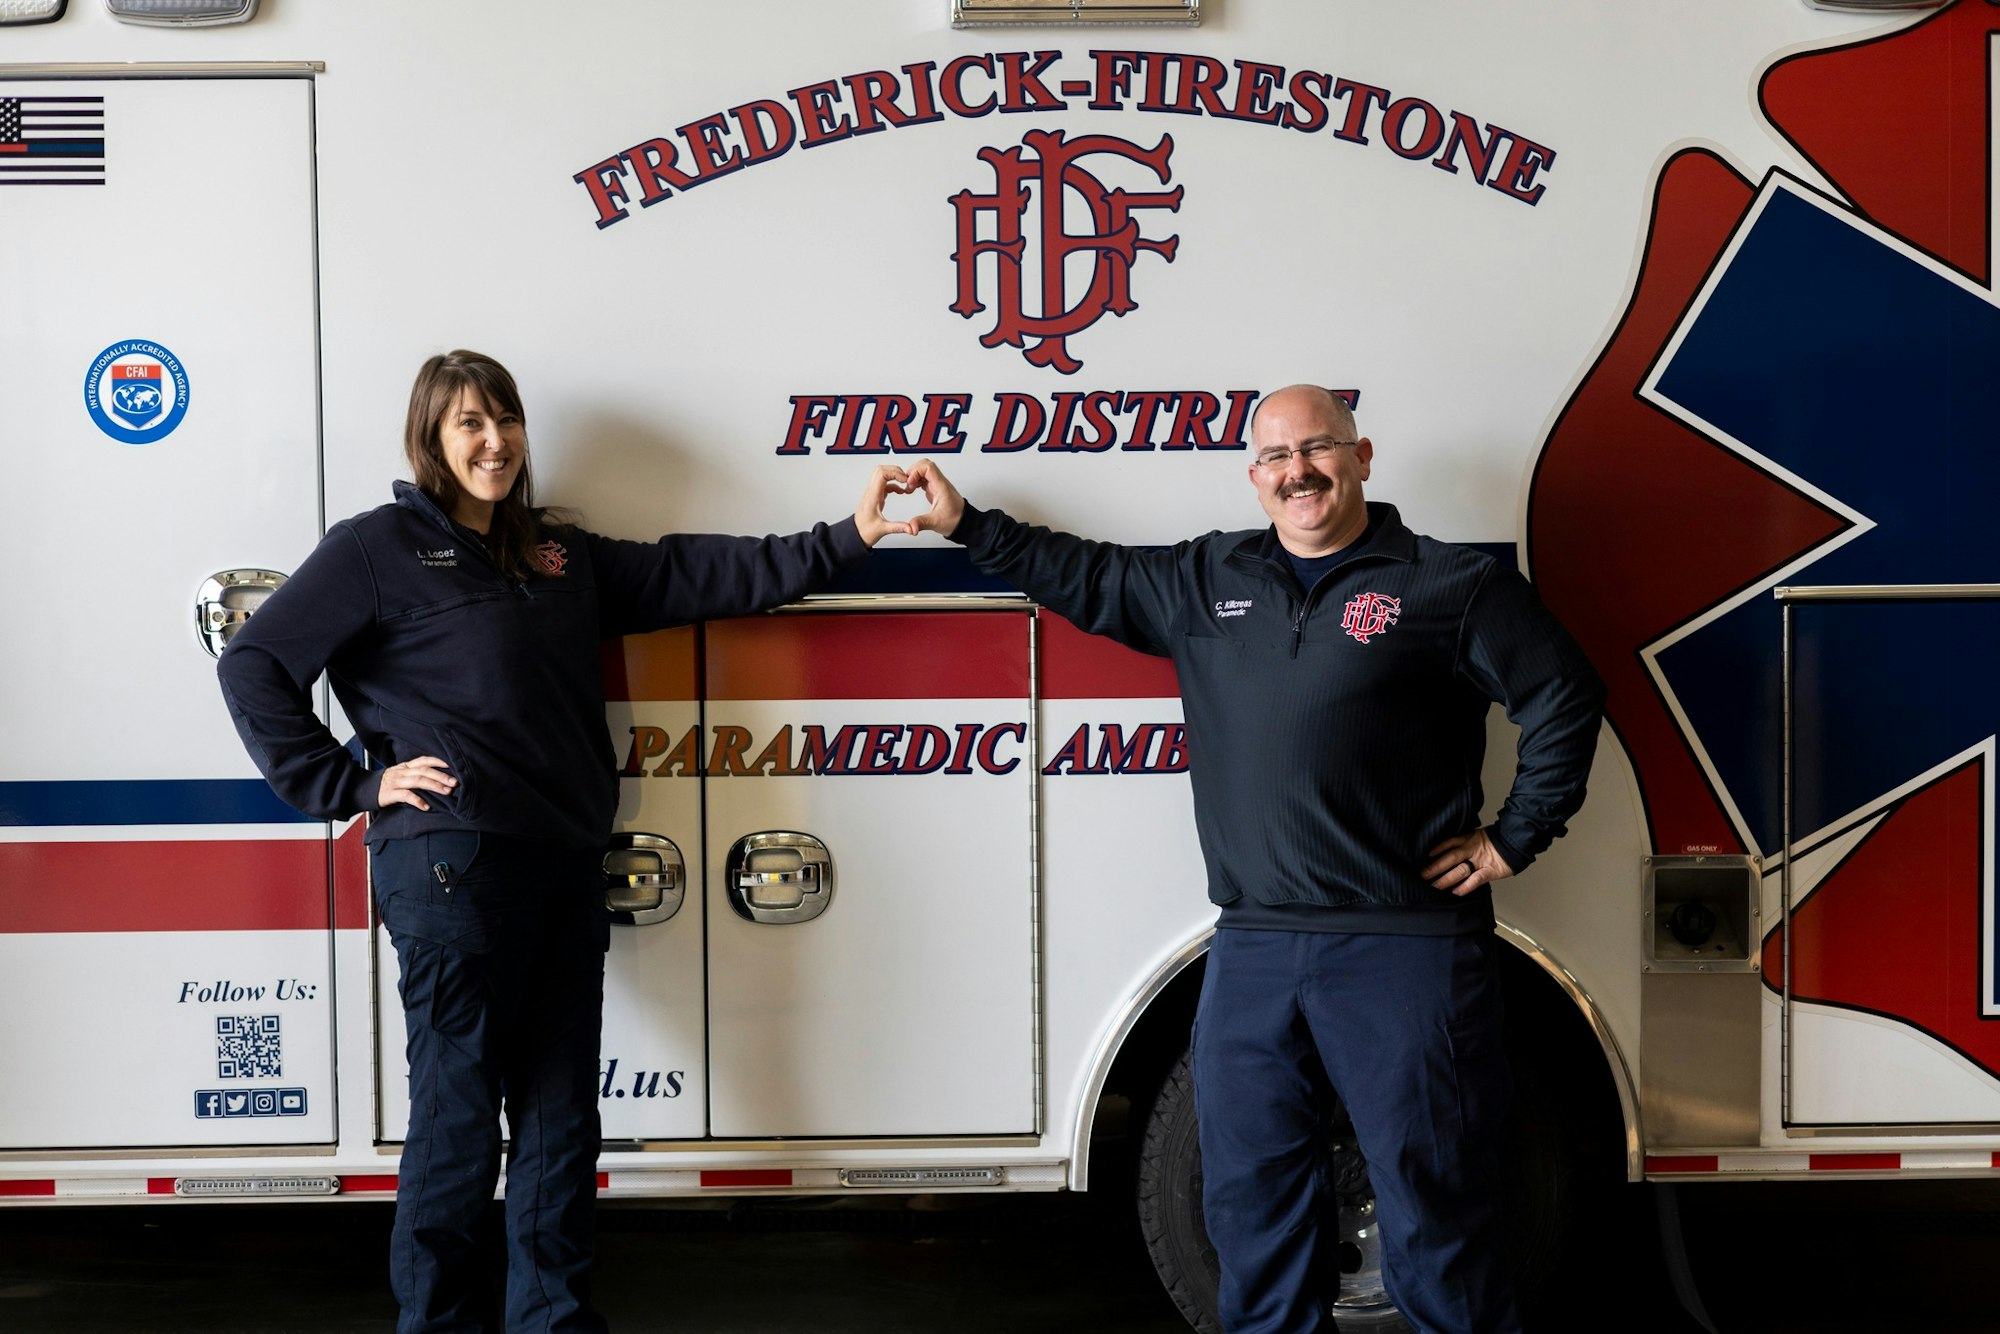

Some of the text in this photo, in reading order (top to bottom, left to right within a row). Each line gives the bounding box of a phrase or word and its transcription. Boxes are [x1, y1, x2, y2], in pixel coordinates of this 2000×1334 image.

[573, 49, 1557, 230] FREDERICK-FIRESTONE
[88, 343, 186, 410] INTERNATIONALLY ACCREDITED AGENCY
[126, 366, 148, 378] CFAI
[776, 389, 1360, 456] FIRE DISTRI
[427, 549, 455, 558] Lopez
[1217, 609, 1246, 617] Paramedic
[618, 722, 1191, 778] PARAMEDIC AMB
[177, 978, 317, 1004] Follow Us:
[598, 1058, 685, 1099] d.us
